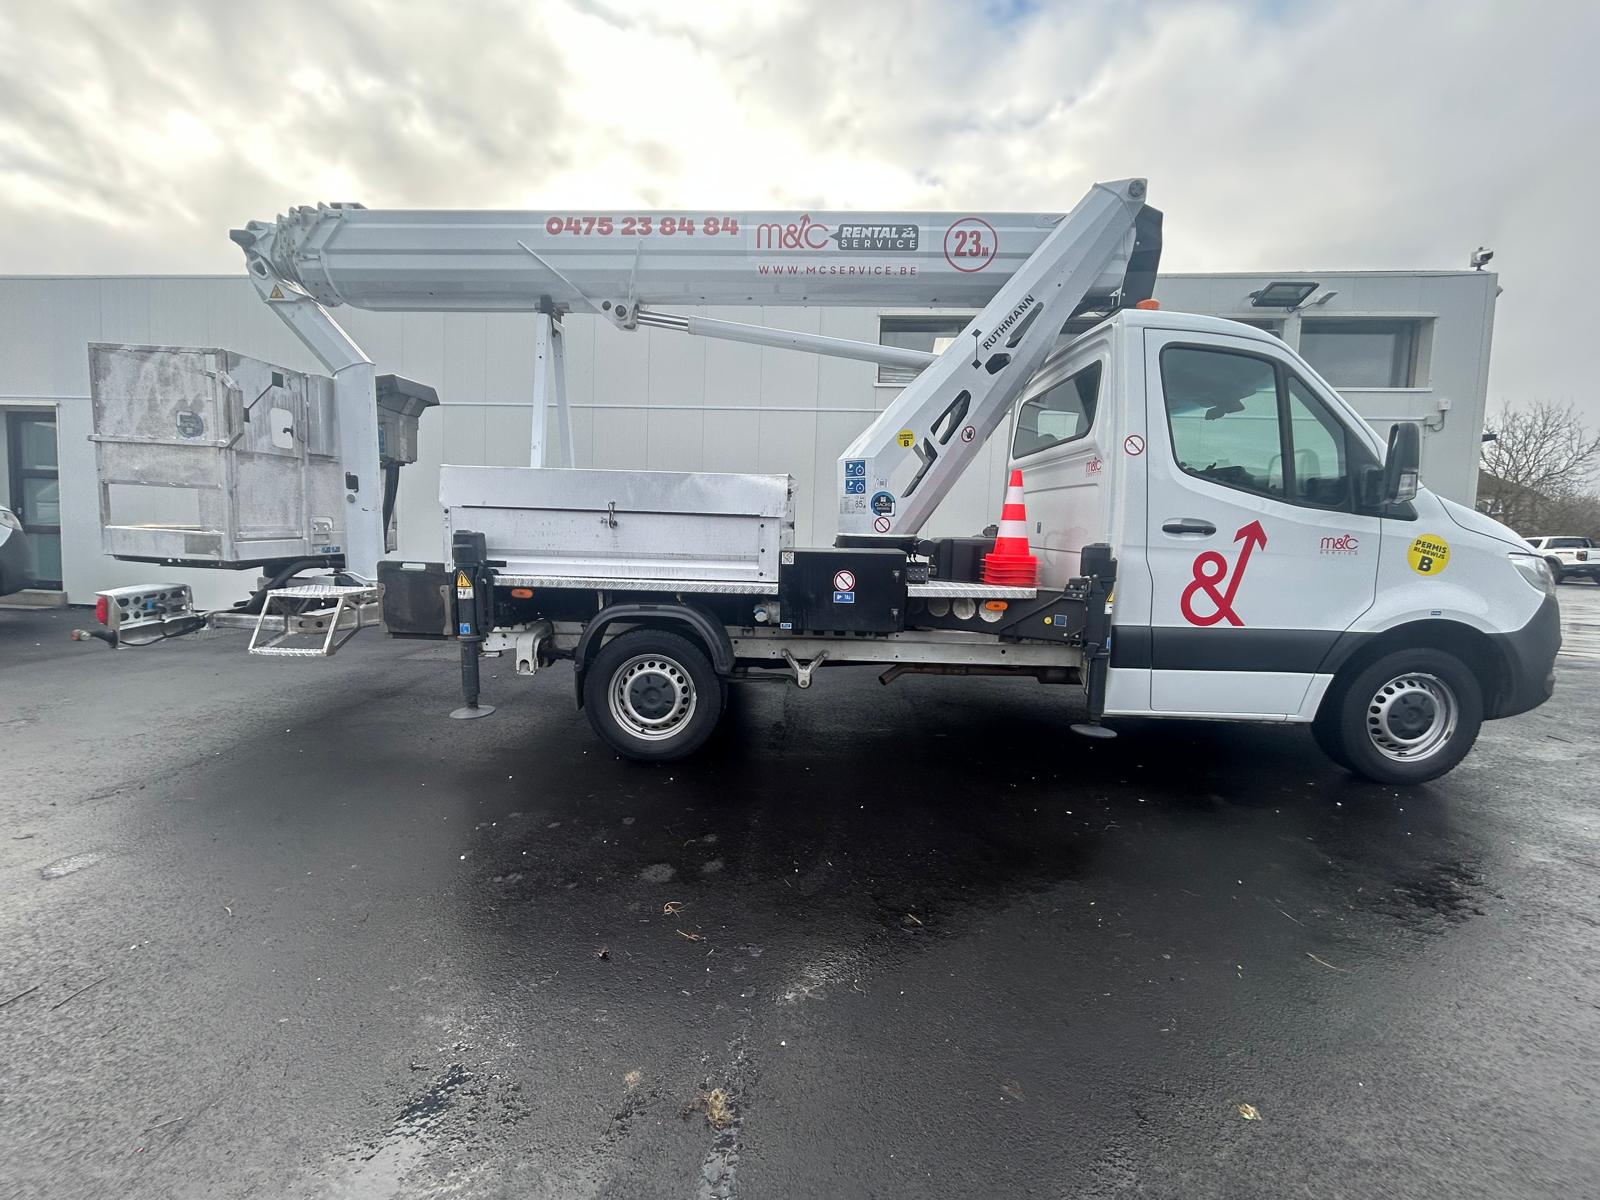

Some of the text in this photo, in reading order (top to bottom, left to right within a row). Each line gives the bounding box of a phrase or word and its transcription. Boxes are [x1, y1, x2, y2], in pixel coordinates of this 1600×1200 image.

[545, 216, 740, 236] 0475 23 84 84
[841, 226, 899, 239] RENTAL
[841, 239, 917, 249] SERVICE
[758, 265, 917, 276] WWW.MCSERVICE.BE
[982, 294, 1035, 351] RUTHMANN
[1415, 539, 1448, 554] PERMIS
[1417, 555, 1434, 573] B
